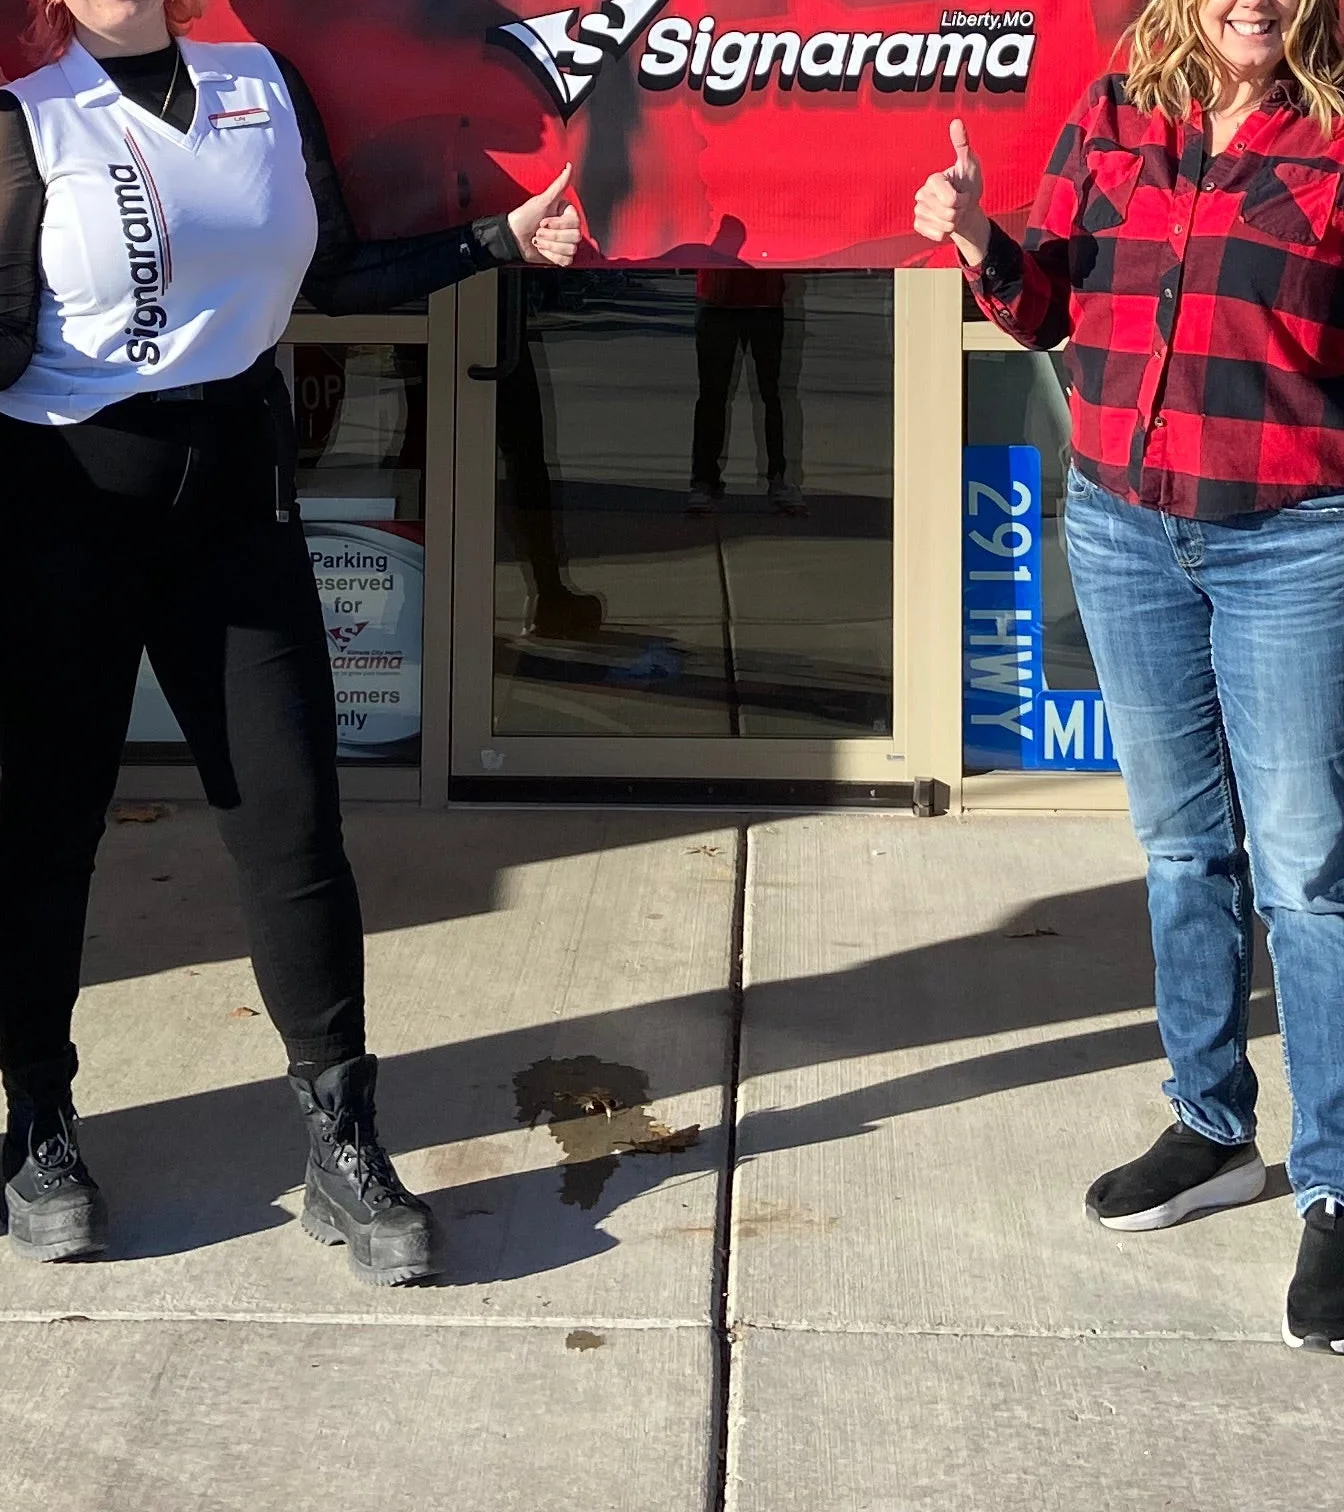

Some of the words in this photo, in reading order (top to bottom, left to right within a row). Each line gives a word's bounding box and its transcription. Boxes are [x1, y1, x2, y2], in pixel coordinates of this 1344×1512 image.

[640, 15, 1036, 96] Signarama
[107, 163, 167, 366] Signarama
[968, 480, 1032, 582] 291
[311, 552, 388, 572] Parking
[316, 574, 394, 591] eserved
[333, 596, 363, 613] for
[331, 656, 404, 670] arama
[969, 609, 1033, 741] HWY
[335, 690, 401, 704] omers
[337, 710, 368, 730] nly
[1044, 699, 1119, 760] MI
